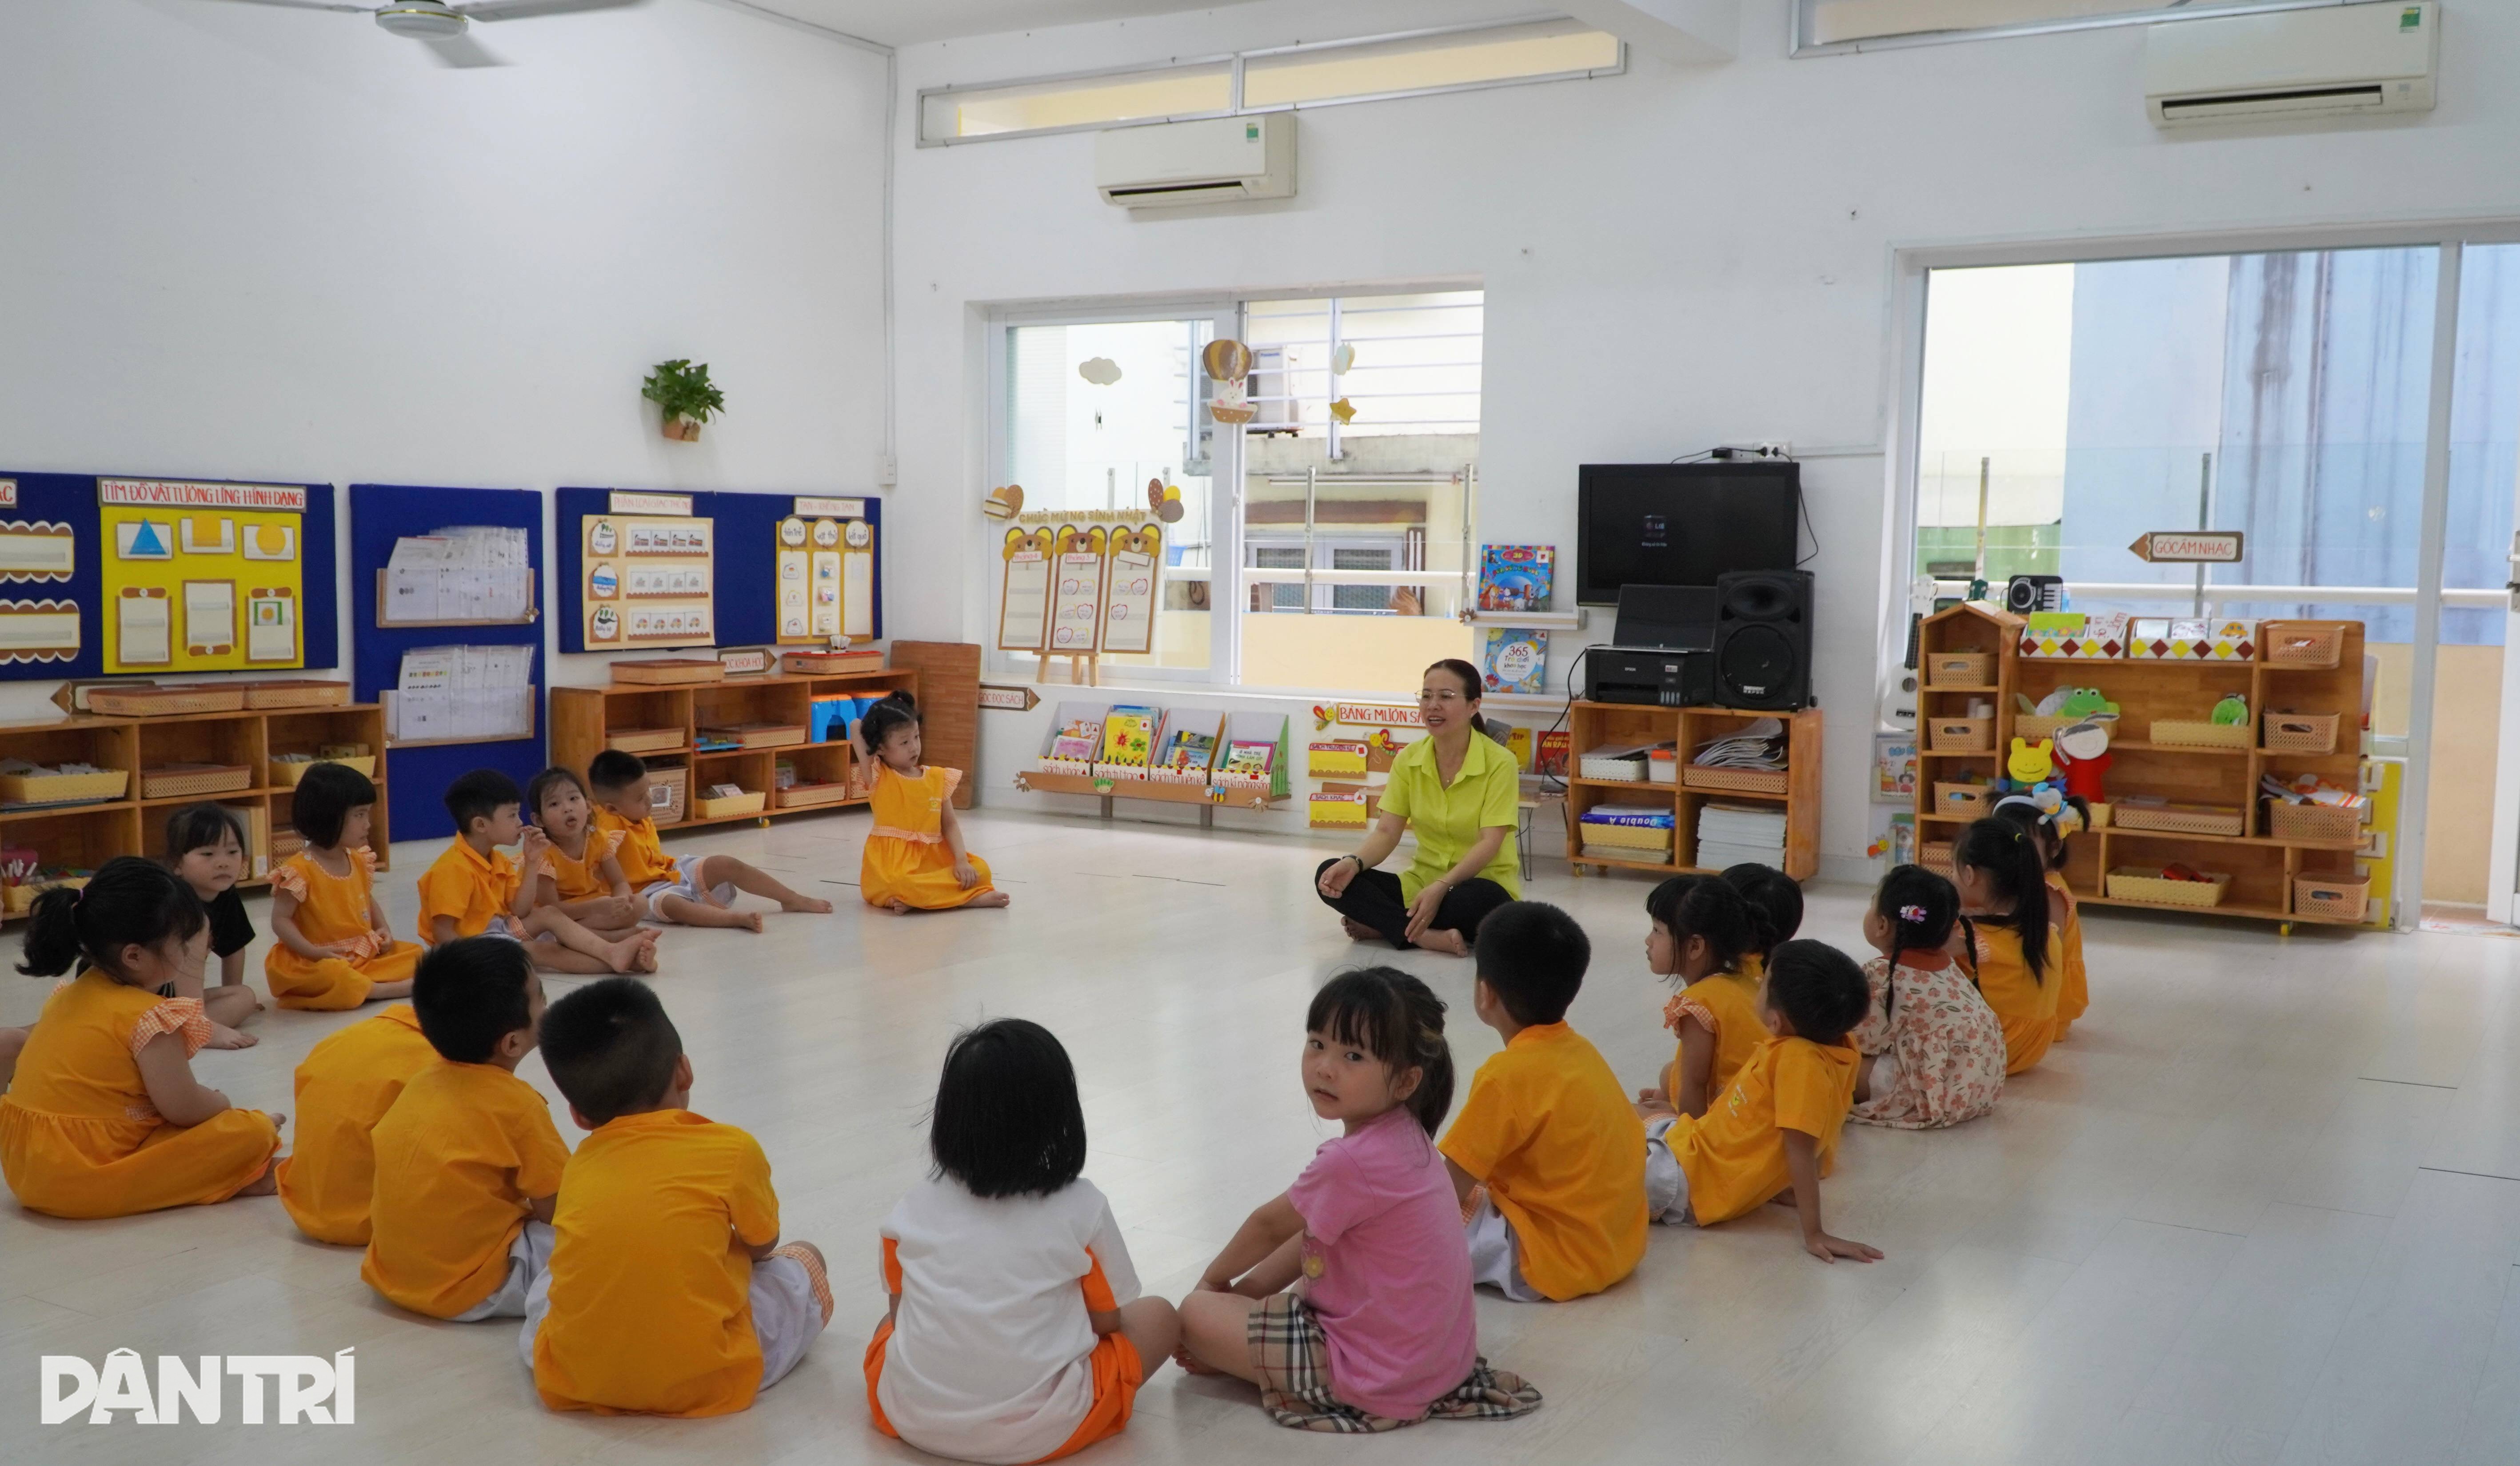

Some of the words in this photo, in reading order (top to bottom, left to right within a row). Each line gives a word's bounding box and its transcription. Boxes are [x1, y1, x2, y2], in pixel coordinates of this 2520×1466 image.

[103, 480, 127, 500] TÌM
[148, 482, 171, 502] VẬT
[273, 490, 303, 507] DẠNG
[2155, 538, 2177, 554] GÓC
[2199, 542, 2232, 557] NHẠC
[1509, 645, 1528, 657] 365
[1340, 705, 1371, 720] BẢNG
[1374, 708, 1407, 724] MƯỢN
[1042, 763, 1060, 774] sách
[1609, 817, 1617, 825] A
[1620, 817, 1657, 826] Double
